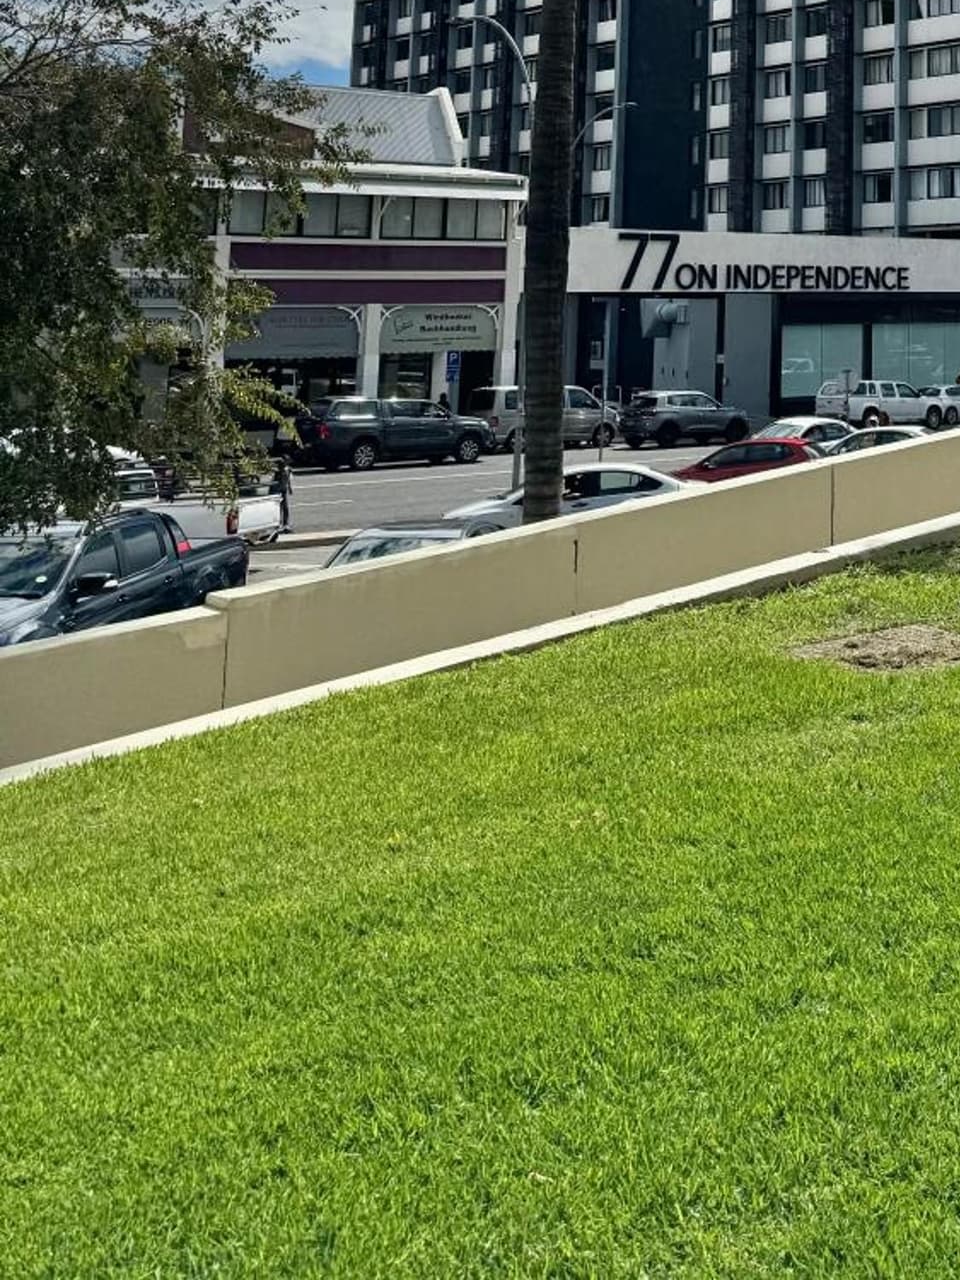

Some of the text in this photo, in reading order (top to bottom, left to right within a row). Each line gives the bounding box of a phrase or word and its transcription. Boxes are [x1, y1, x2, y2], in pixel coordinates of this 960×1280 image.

[618, 232, 910, 290] 77 ON INDEPENDENCE
